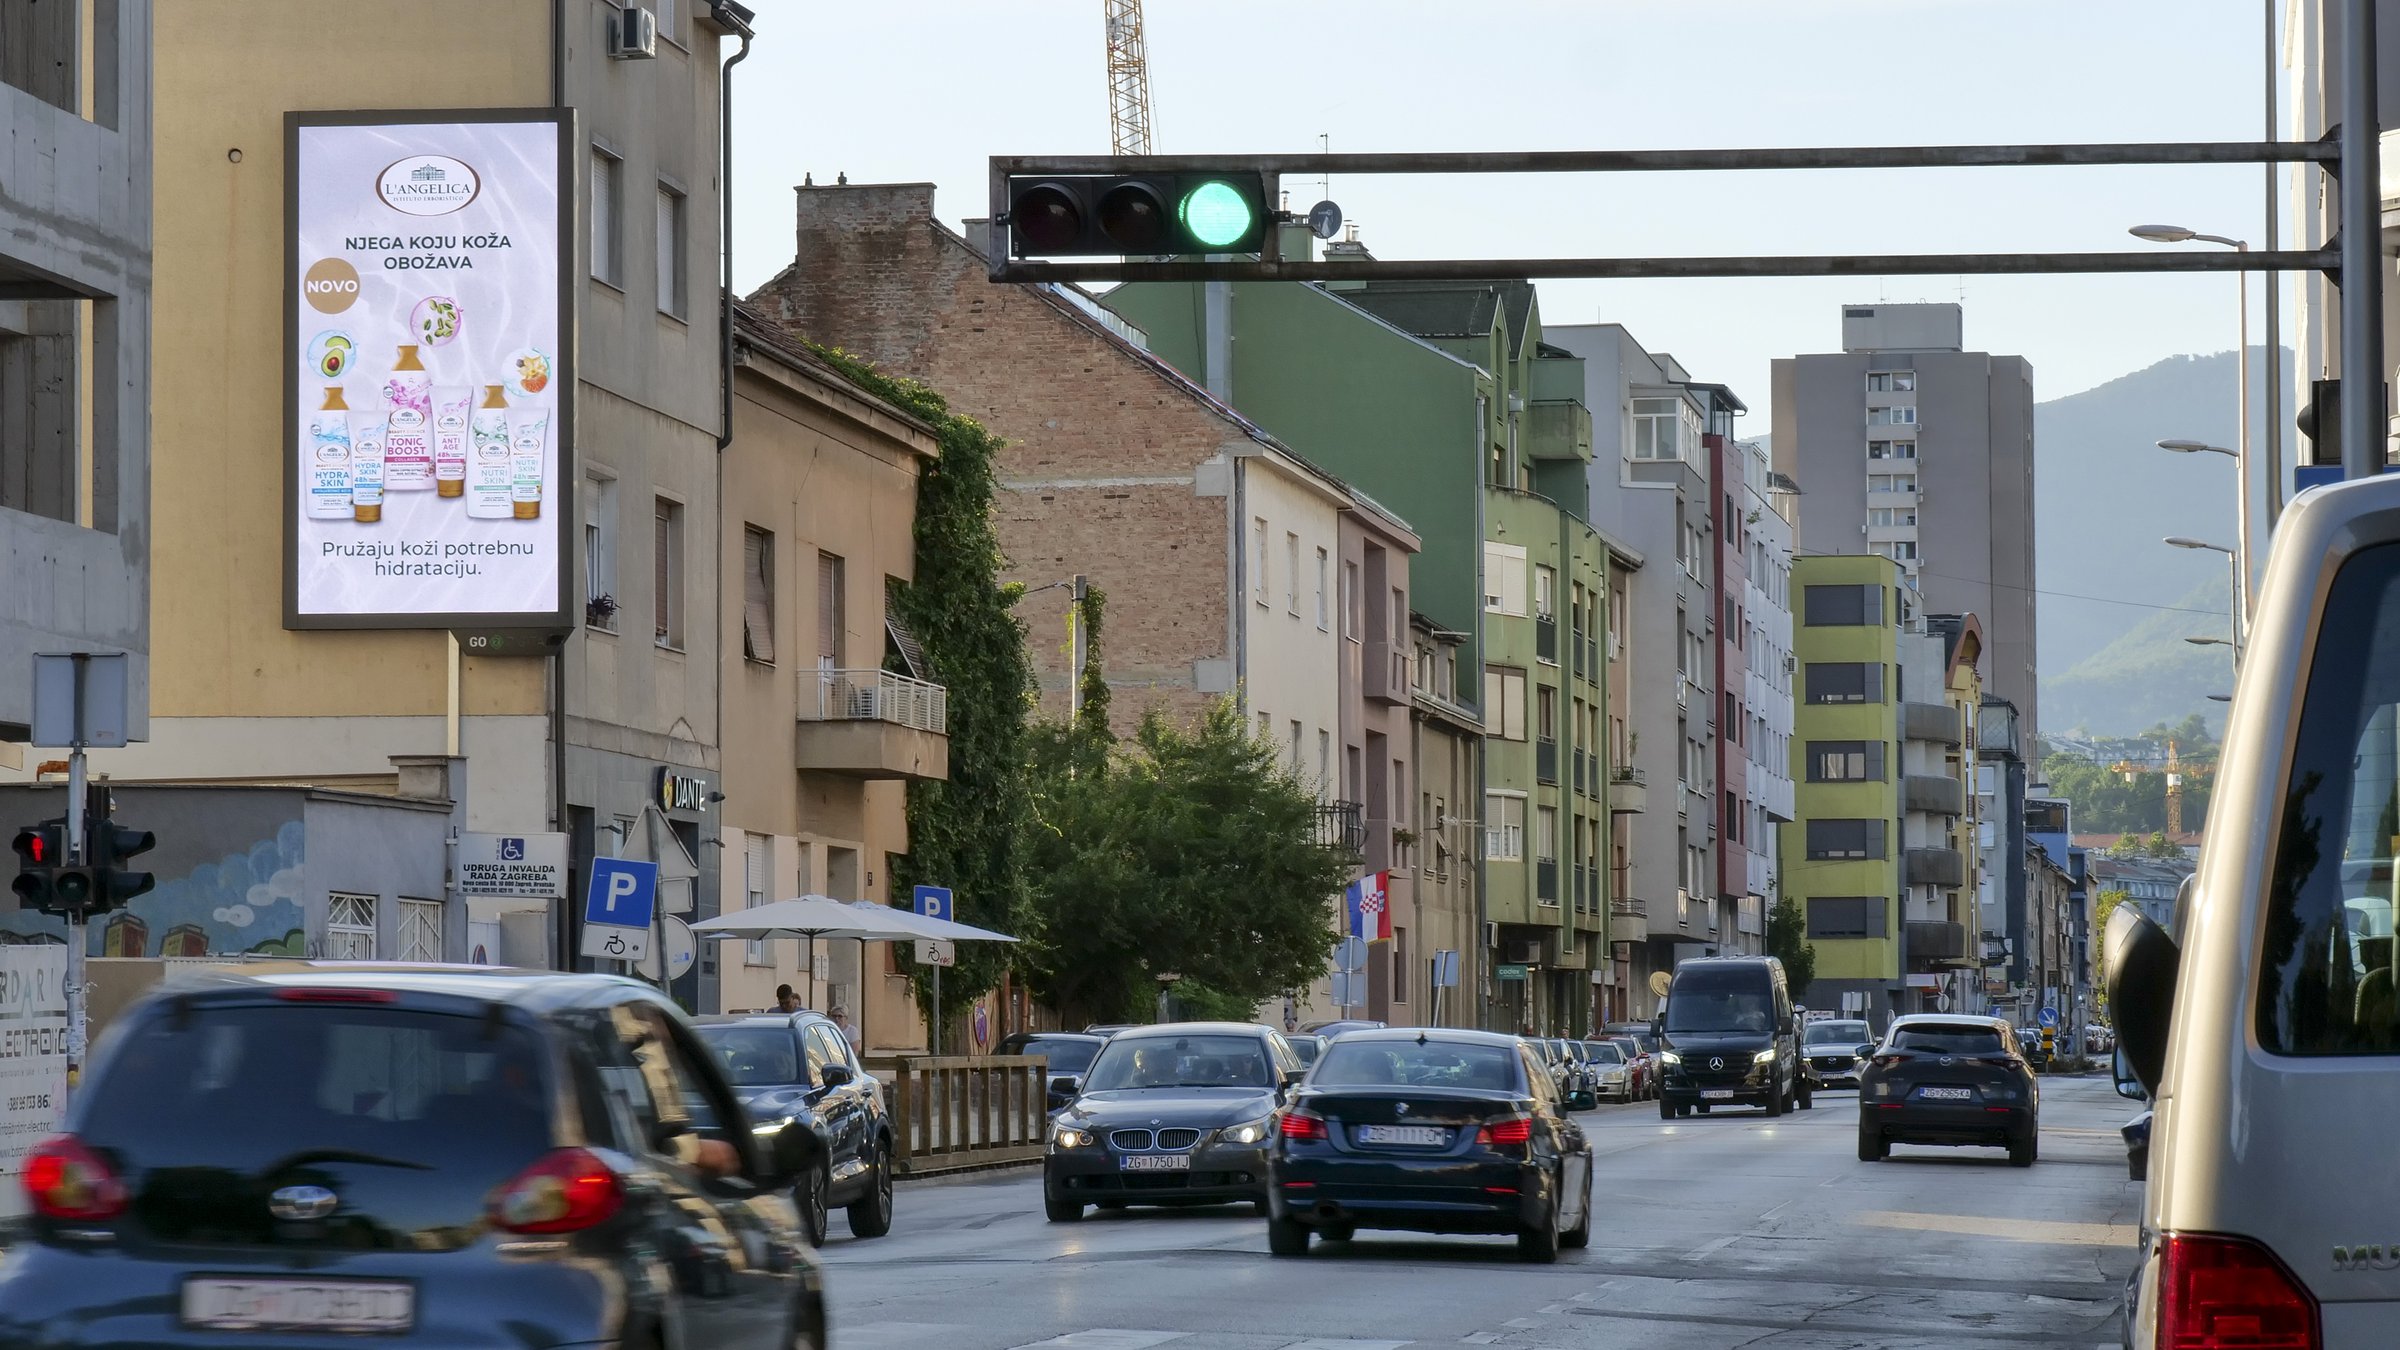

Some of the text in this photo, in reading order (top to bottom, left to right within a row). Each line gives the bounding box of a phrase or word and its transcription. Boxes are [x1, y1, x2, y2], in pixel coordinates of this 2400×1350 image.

[386, 183, 471, 195] L'ANGELICA
[345, 232, 512, 250] NJEGA KOJU KOŽA
[384, 252, 473, 270] OBOŽAVA
[307, 280, 358, 293] NOVO
[390, 438, 423, 446] TONIC
[387, 447, 426, 455] BOOST
[315, 471, 350, 479] HYDRA
[481, 469, 508, 477] NUTRI
[320, 479, 344, 487] SKIN
[322, 540, 534, 560] Pružaju koži potrebnu
[375, 560, 482, 578] hidrataciju.
[469, 636, 487, 648] GO
[675, 775, 706, 812] DANTE
[463, 864, 555, 873] UDRUGA INVALIDA
[470, 872, 548, 881] RADA ZAGREBA
[606, 871, 637, 911] P
[924, 896, 941, 917] P
